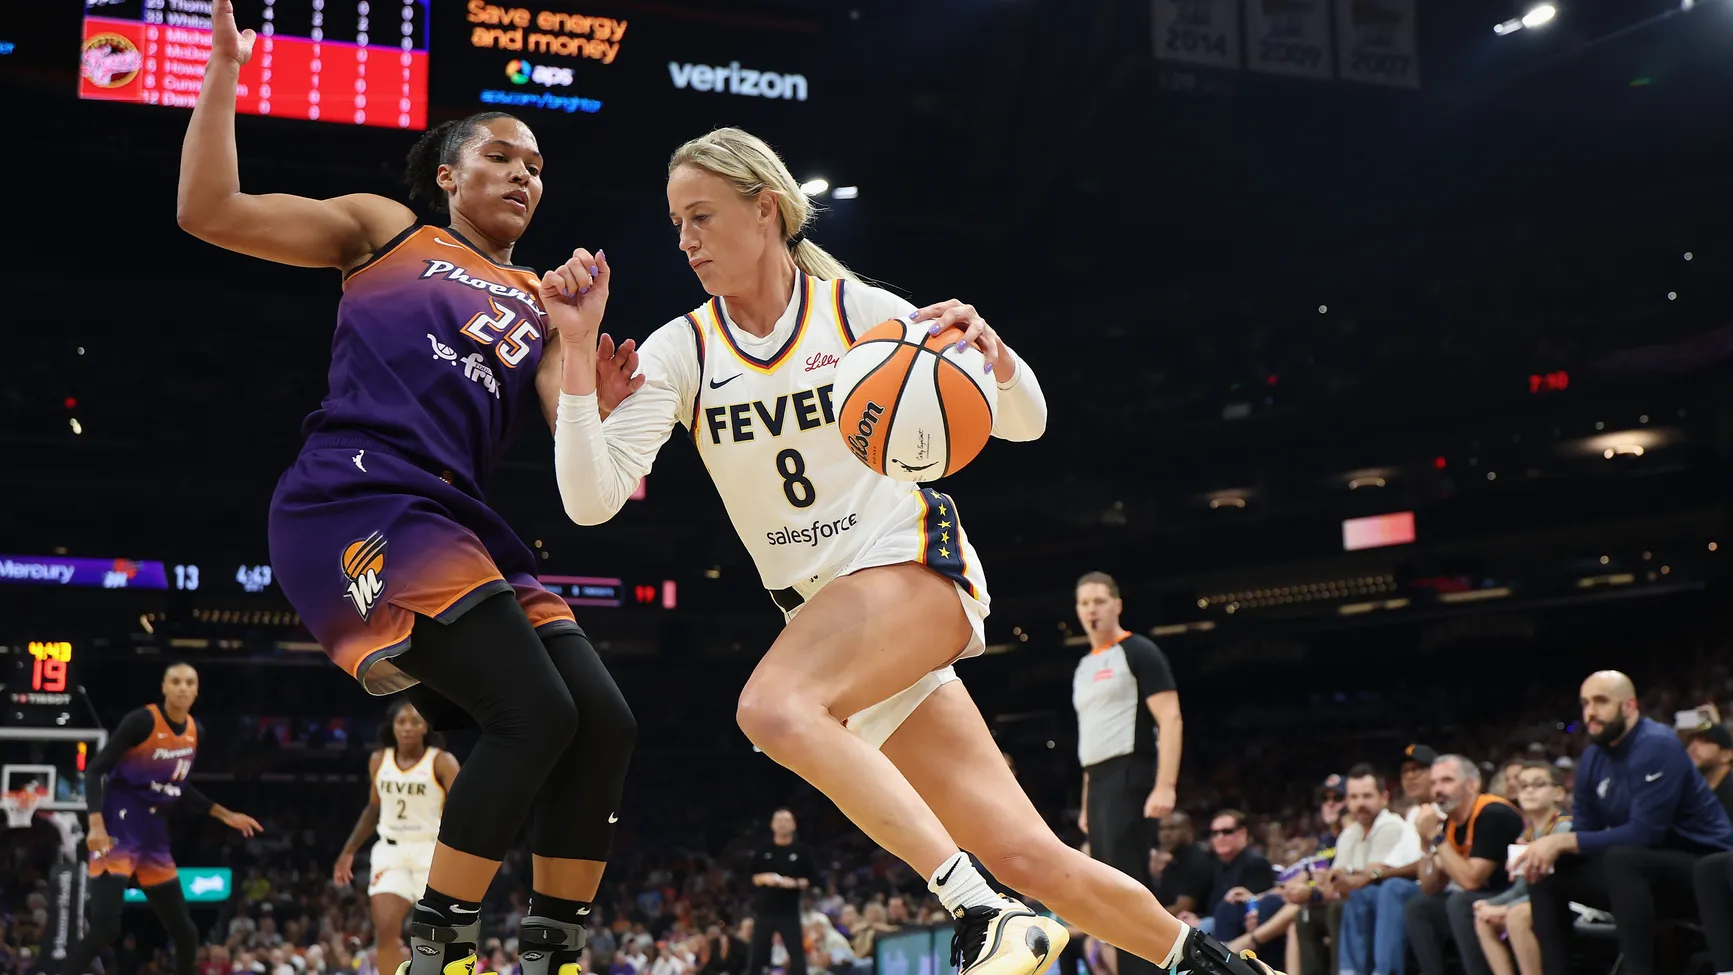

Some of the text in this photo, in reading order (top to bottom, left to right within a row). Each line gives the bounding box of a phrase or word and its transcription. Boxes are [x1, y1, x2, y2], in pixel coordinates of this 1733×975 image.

[467, 0, 628, 42] Save energy
[471, 27, 620, 64] and money
[532, 65, 574, 87] aps
[668, 60, 808, 101] verizon
[418, 259, 548, 317] Phoenix
[460, 297, 540, 369] 25
[804, 352, 840, 372] Lilly
[847, 400, 886, 469] ilson
[775, 448, 816, 509] 8
[766, 513, 858, 547] salesforce
[174, 564, 200, 590] 13
[28, 641, 72, 662] 4:43
[32, 659, 68, 692] 19
[380, 780, 427, 796] FEVER
[396, 799, 407, 820] 2
